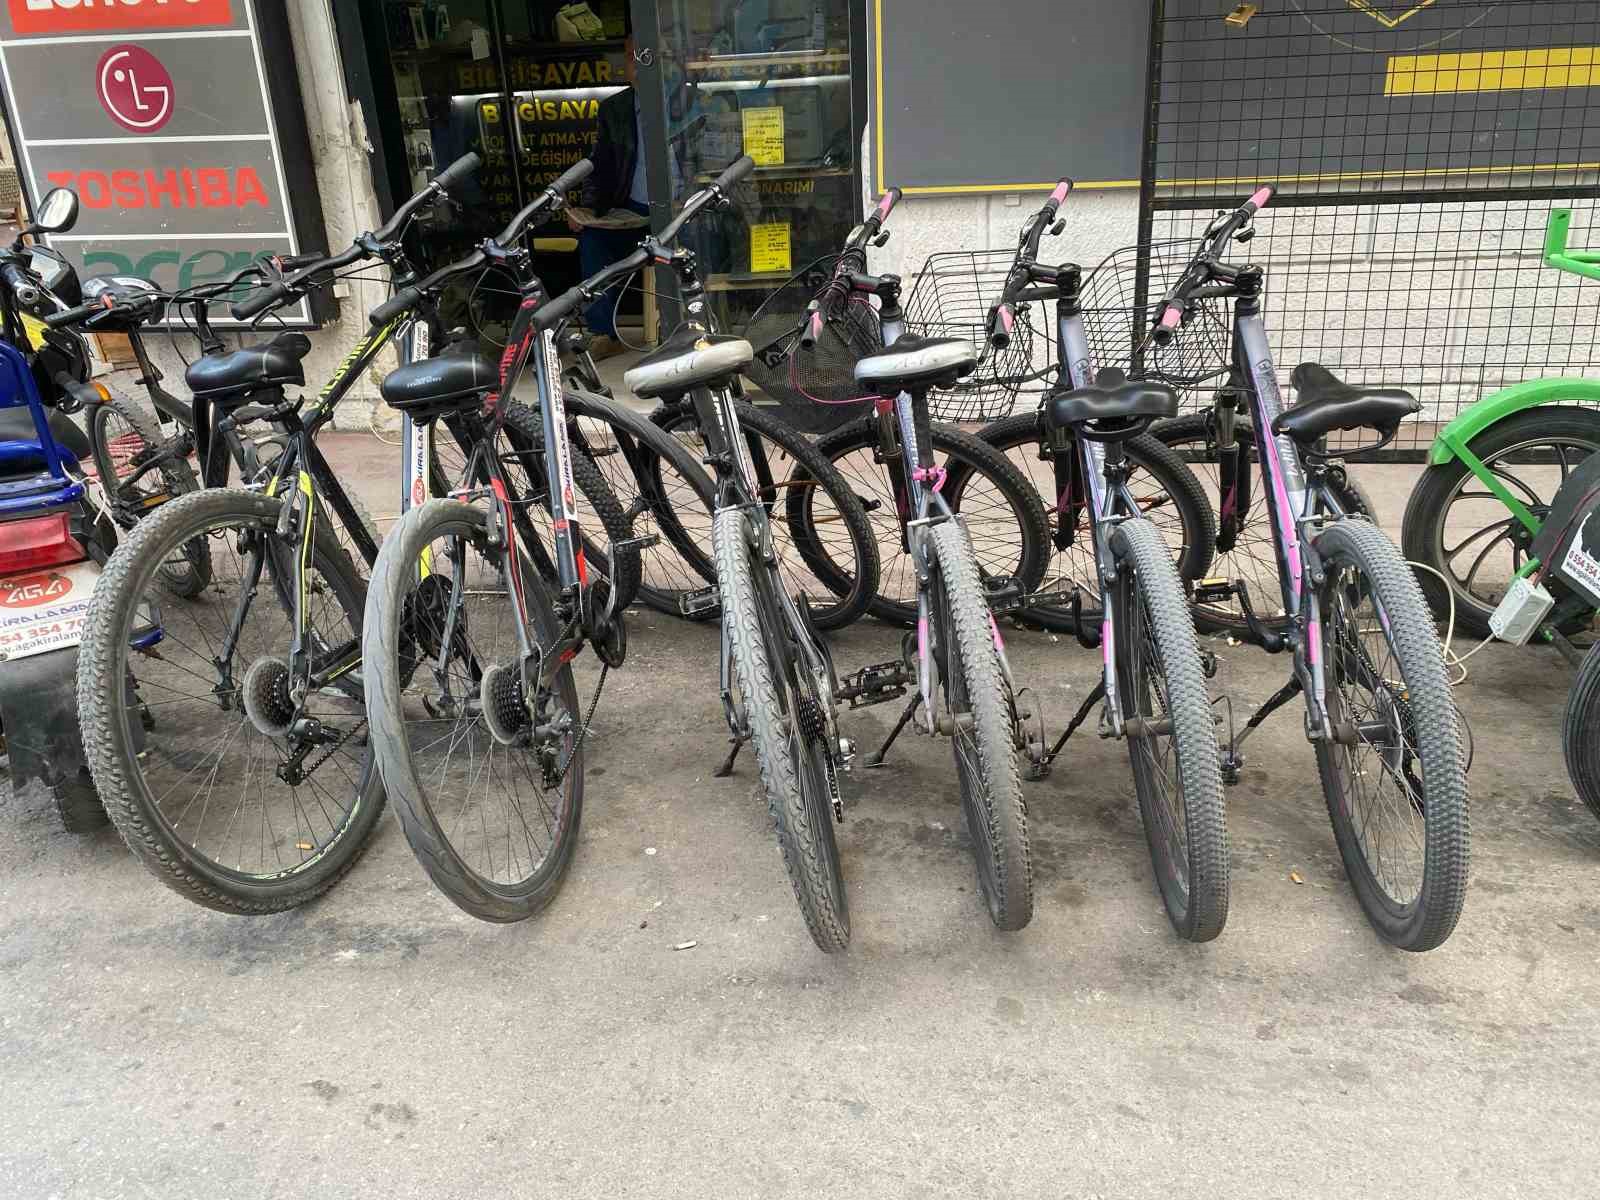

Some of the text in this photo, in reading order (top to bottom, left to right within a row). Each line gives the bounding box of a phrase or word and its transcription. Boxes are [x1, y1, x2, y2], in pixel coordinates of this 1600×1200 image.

[100, 49, 170, 128] LG
[47, 166, 269, 208] TOSHIBA
[28, 623, 62, 638] 354
